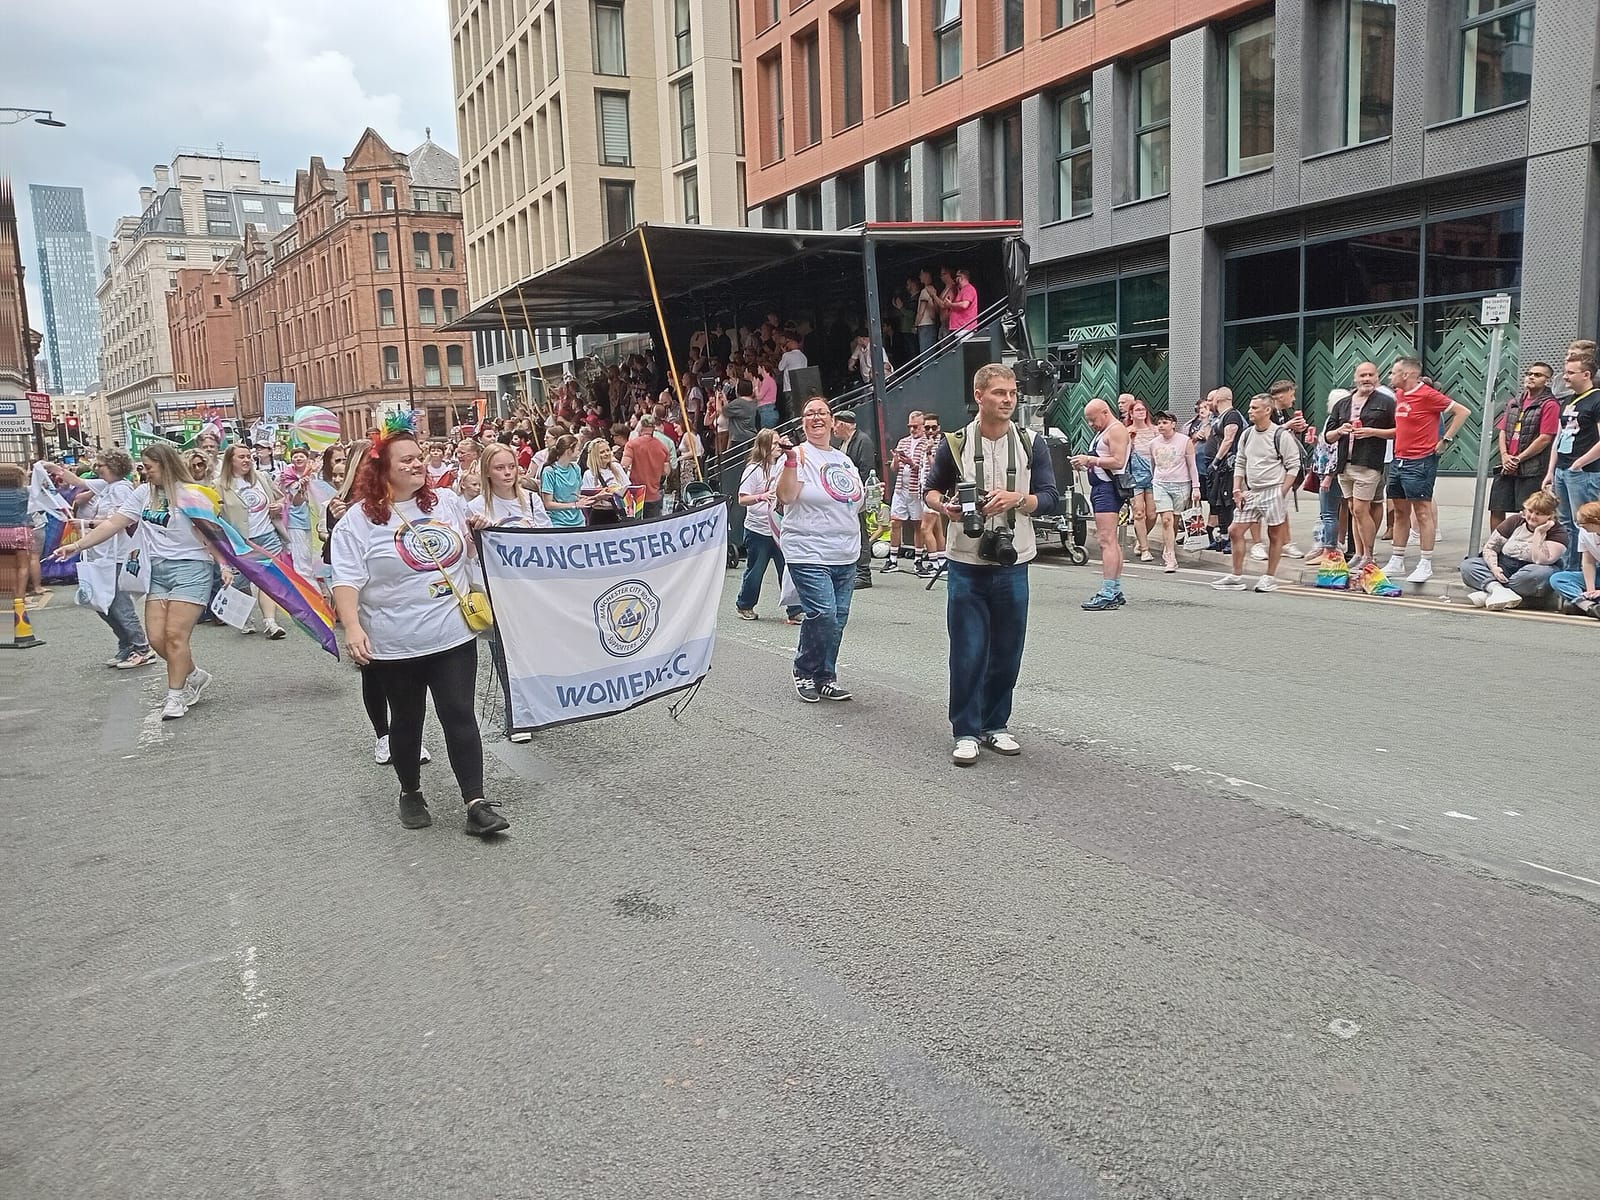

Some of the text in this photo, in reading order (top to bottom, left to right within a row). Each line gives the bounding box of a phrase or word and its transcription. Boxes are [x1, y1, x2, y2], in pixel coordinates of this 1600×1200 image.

[496, 515, 720, 570] MANCHESTER CITY
[599, 587, 629, 619] MANCHESTER
[629, 586, 641, 594] CITY
[640, 591, 656, 611] WOMEN
[640, 627, 652, 642] CLUB
[556, 667, 660, 708] WOMEN
